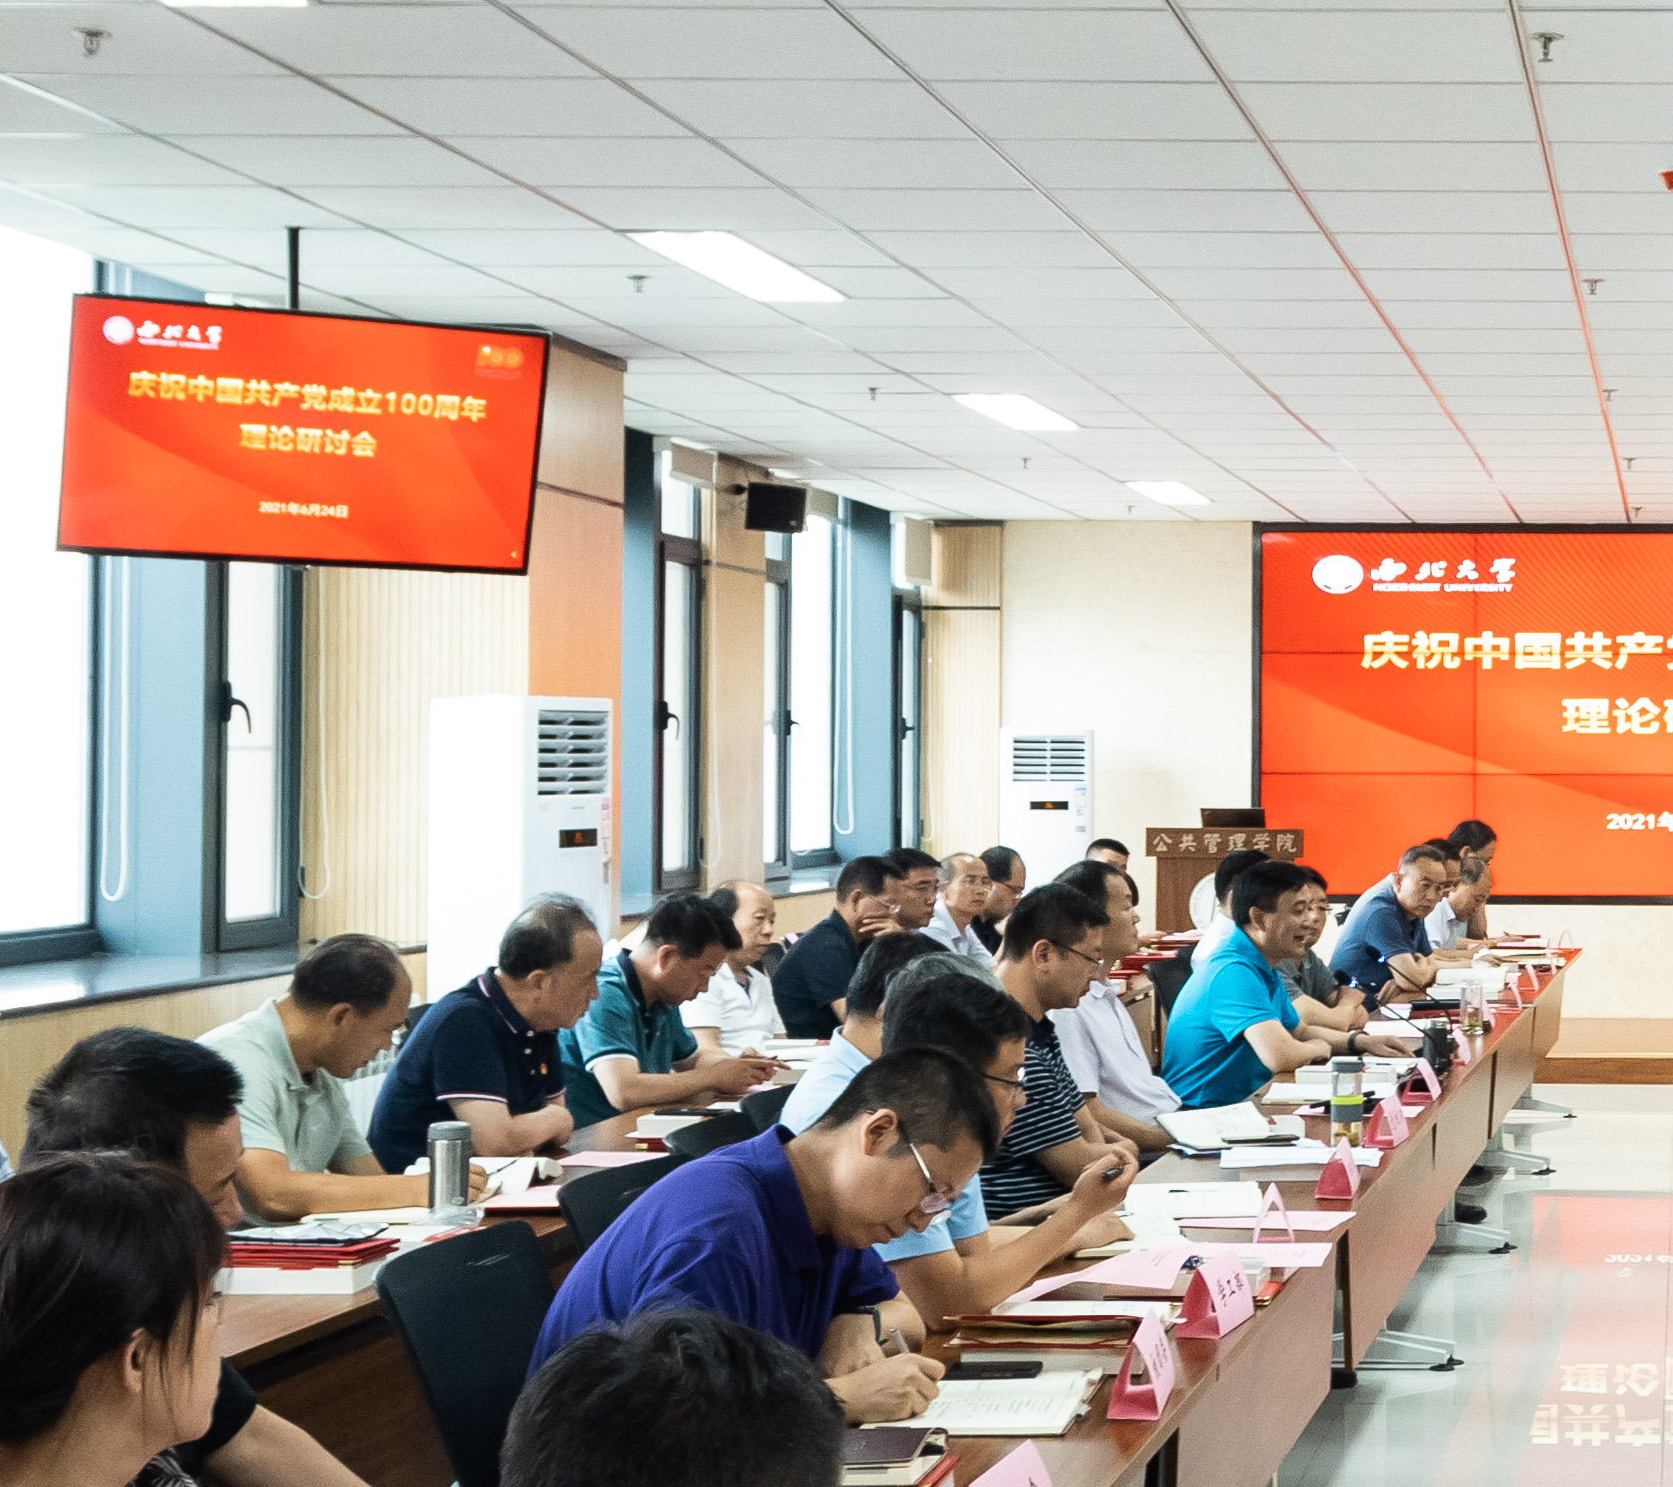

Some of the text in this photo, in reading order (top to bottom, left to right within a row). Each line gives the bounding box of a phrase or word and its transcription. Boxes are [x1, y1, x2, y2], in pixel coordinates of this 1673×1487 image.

[128, 370, 487, 422] 庆祝中国共产党成立100周年
[238, 422, 378, 458] 理论研讨会
[258, 500, 349, 519] 2021年6月24日
[1152, 831, 1298, 854] 公共管理学院
